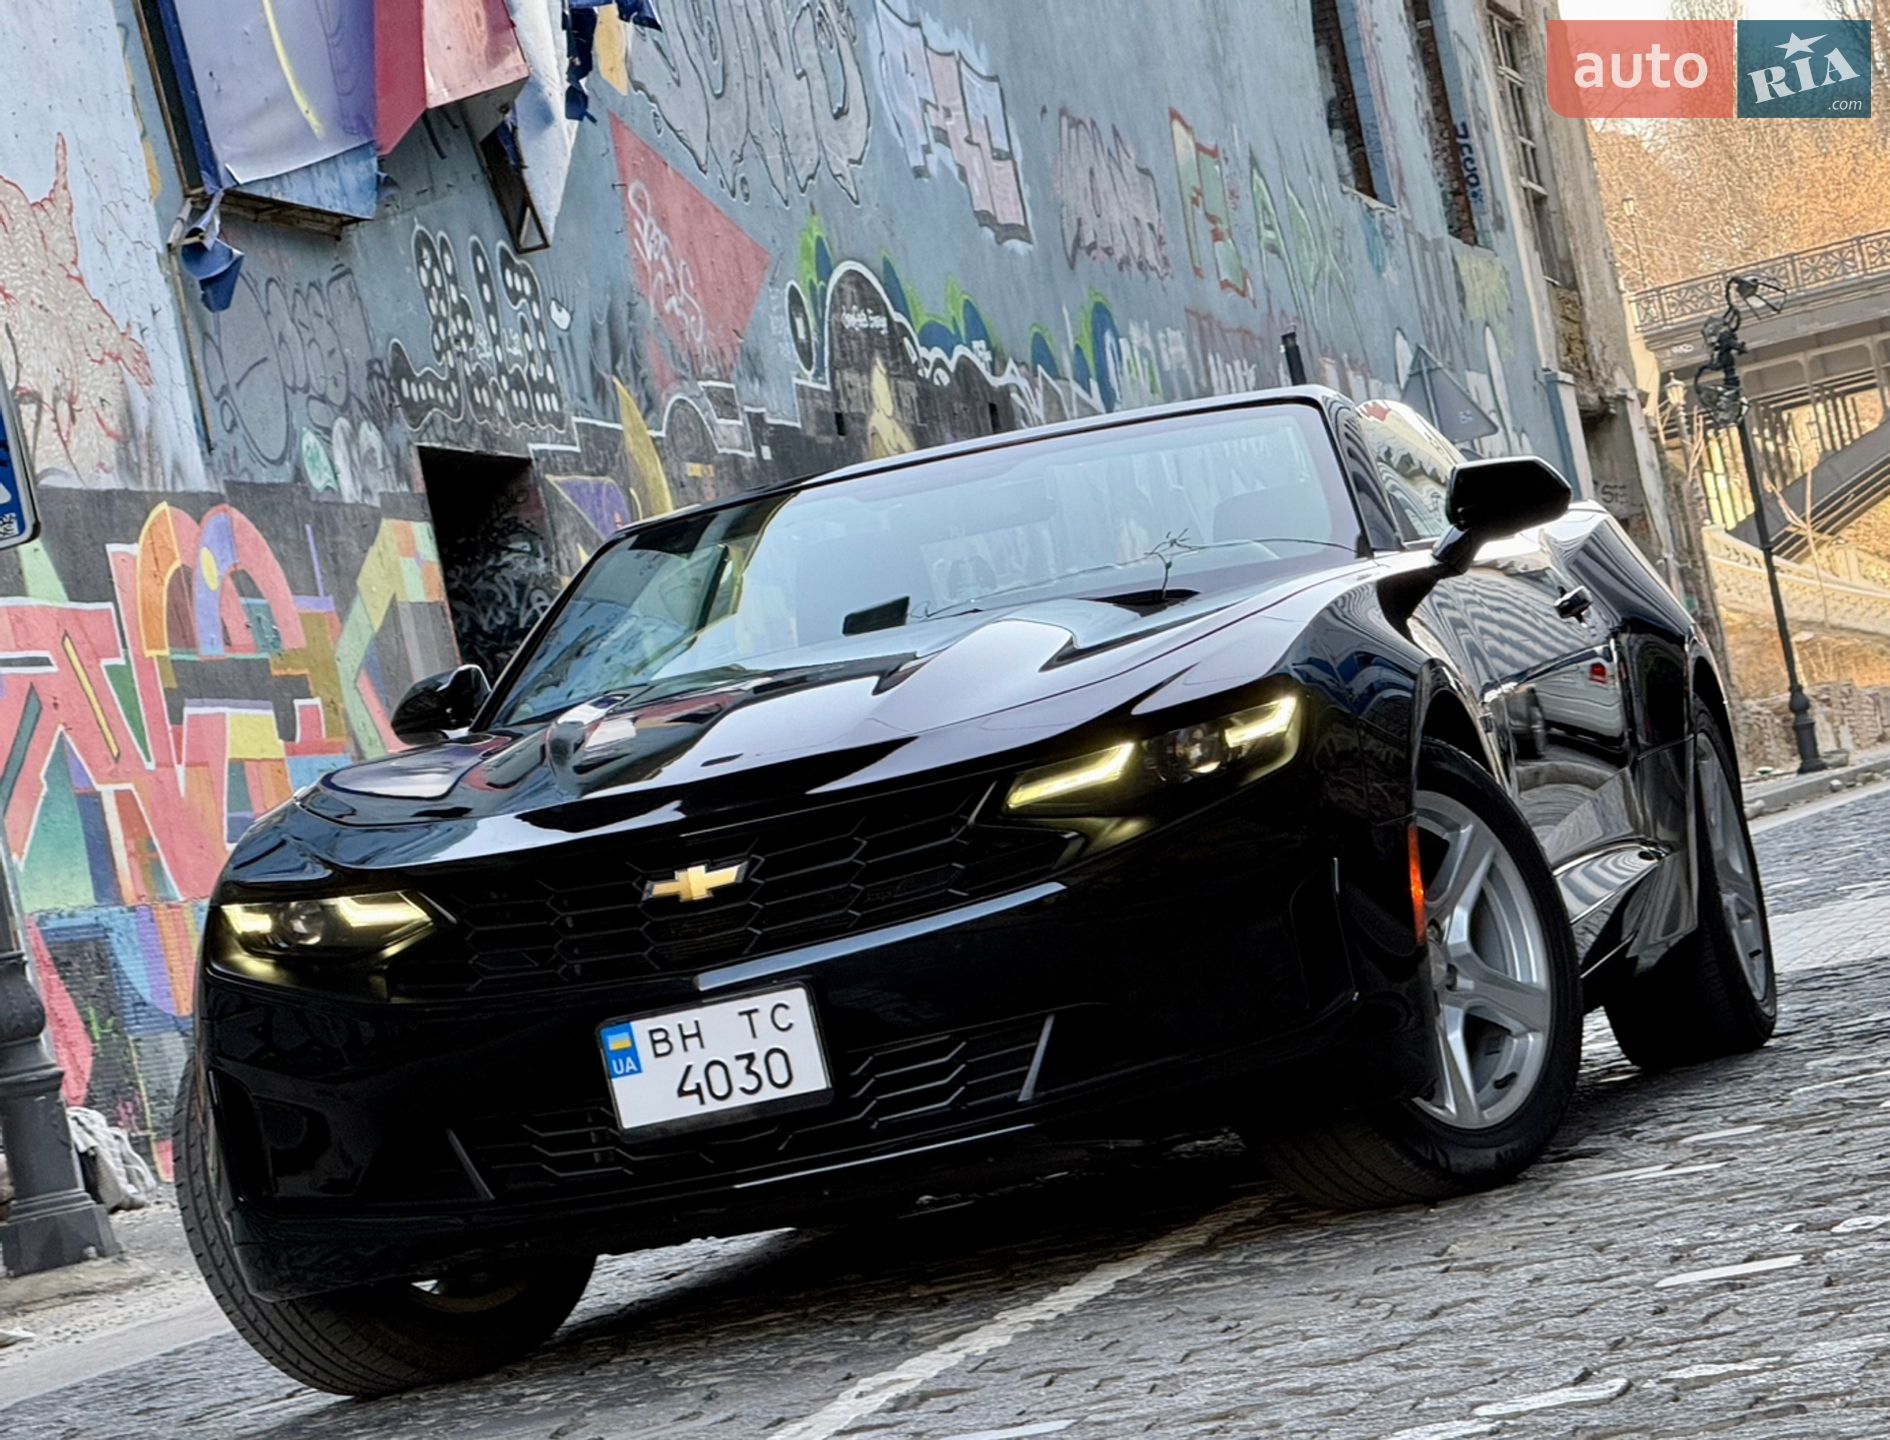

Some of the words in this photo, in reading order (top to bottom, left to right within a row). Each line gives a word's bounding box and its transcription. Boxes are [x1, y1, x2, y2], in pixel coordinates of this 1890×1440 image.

[648, 1019, 705, 1058] BH
[738, 1002, 795, 1039] TC
[611, 1056, 638, 1075] UA
[676, 1047, 794, 1106] 4030
